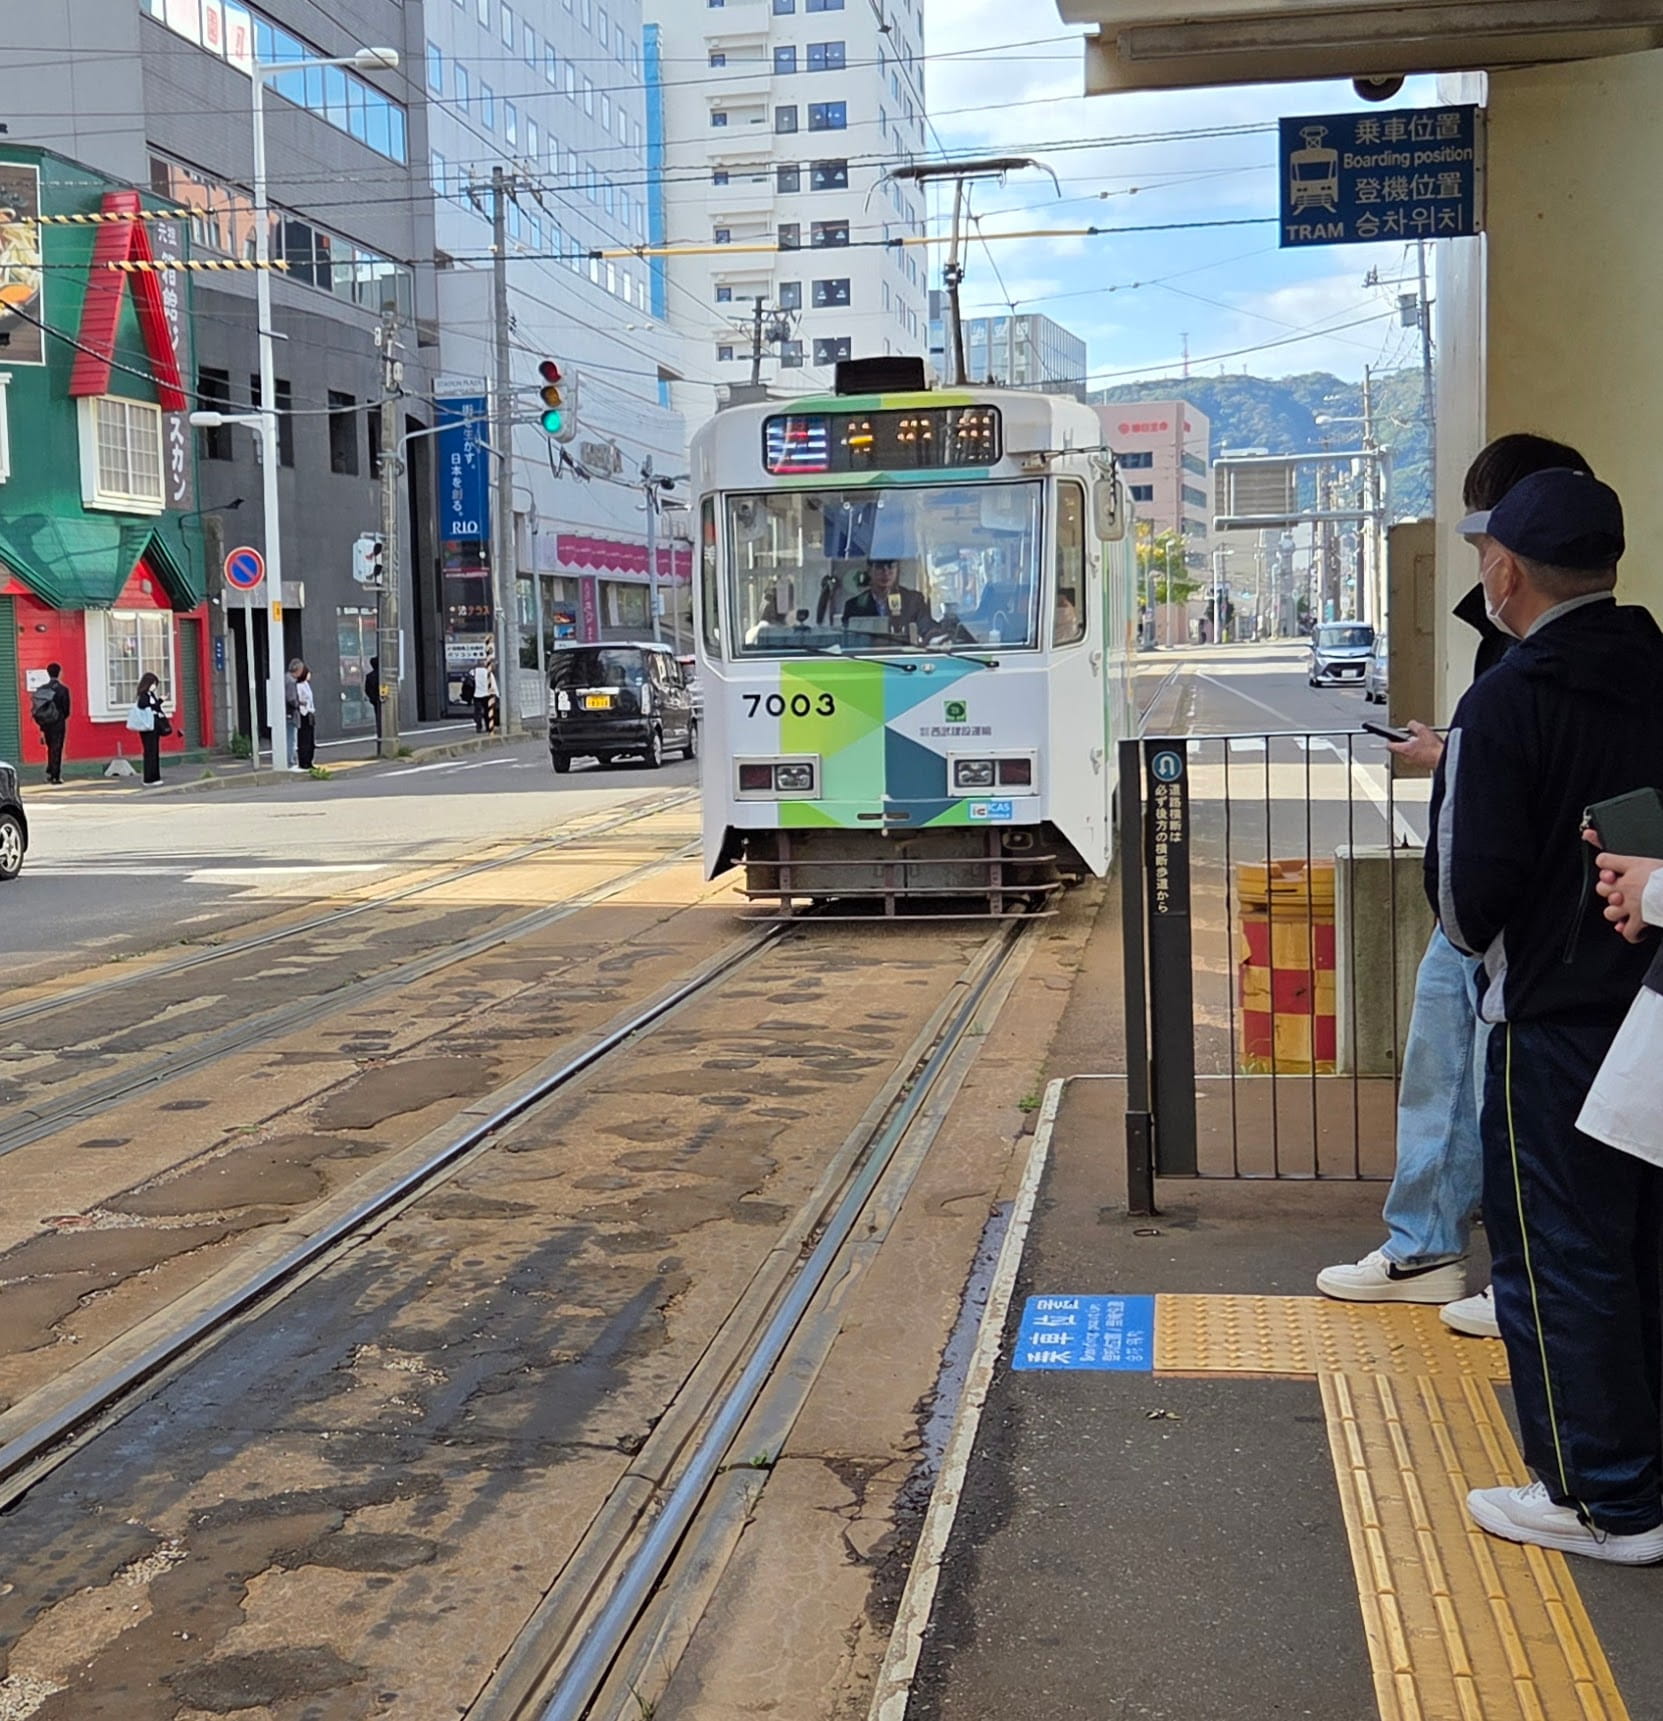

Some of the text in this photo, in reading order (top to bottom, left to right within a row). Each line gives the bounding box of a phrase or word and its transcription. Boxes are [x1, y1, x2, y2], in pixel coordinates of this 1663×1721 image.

[1354, 112, 1462, 145] 乗車位置
[1343, 144, 1473, 169] Boarding position
[1355, 171, 1463, 204] 登機位置
[1286, 222, 1345, 240] TRAM
[1355, 203, 1463, 238] 승차위치
[452, 521, 478, 534] RIO
[742, 693, 835, 718] 7003
[1169, 783, 1182, 843] 道路横断は
[1155, 783, 1169, 913] 必ず後方の横断歩道から
[1026, 1300, 1079, 1364] 乗車位置
